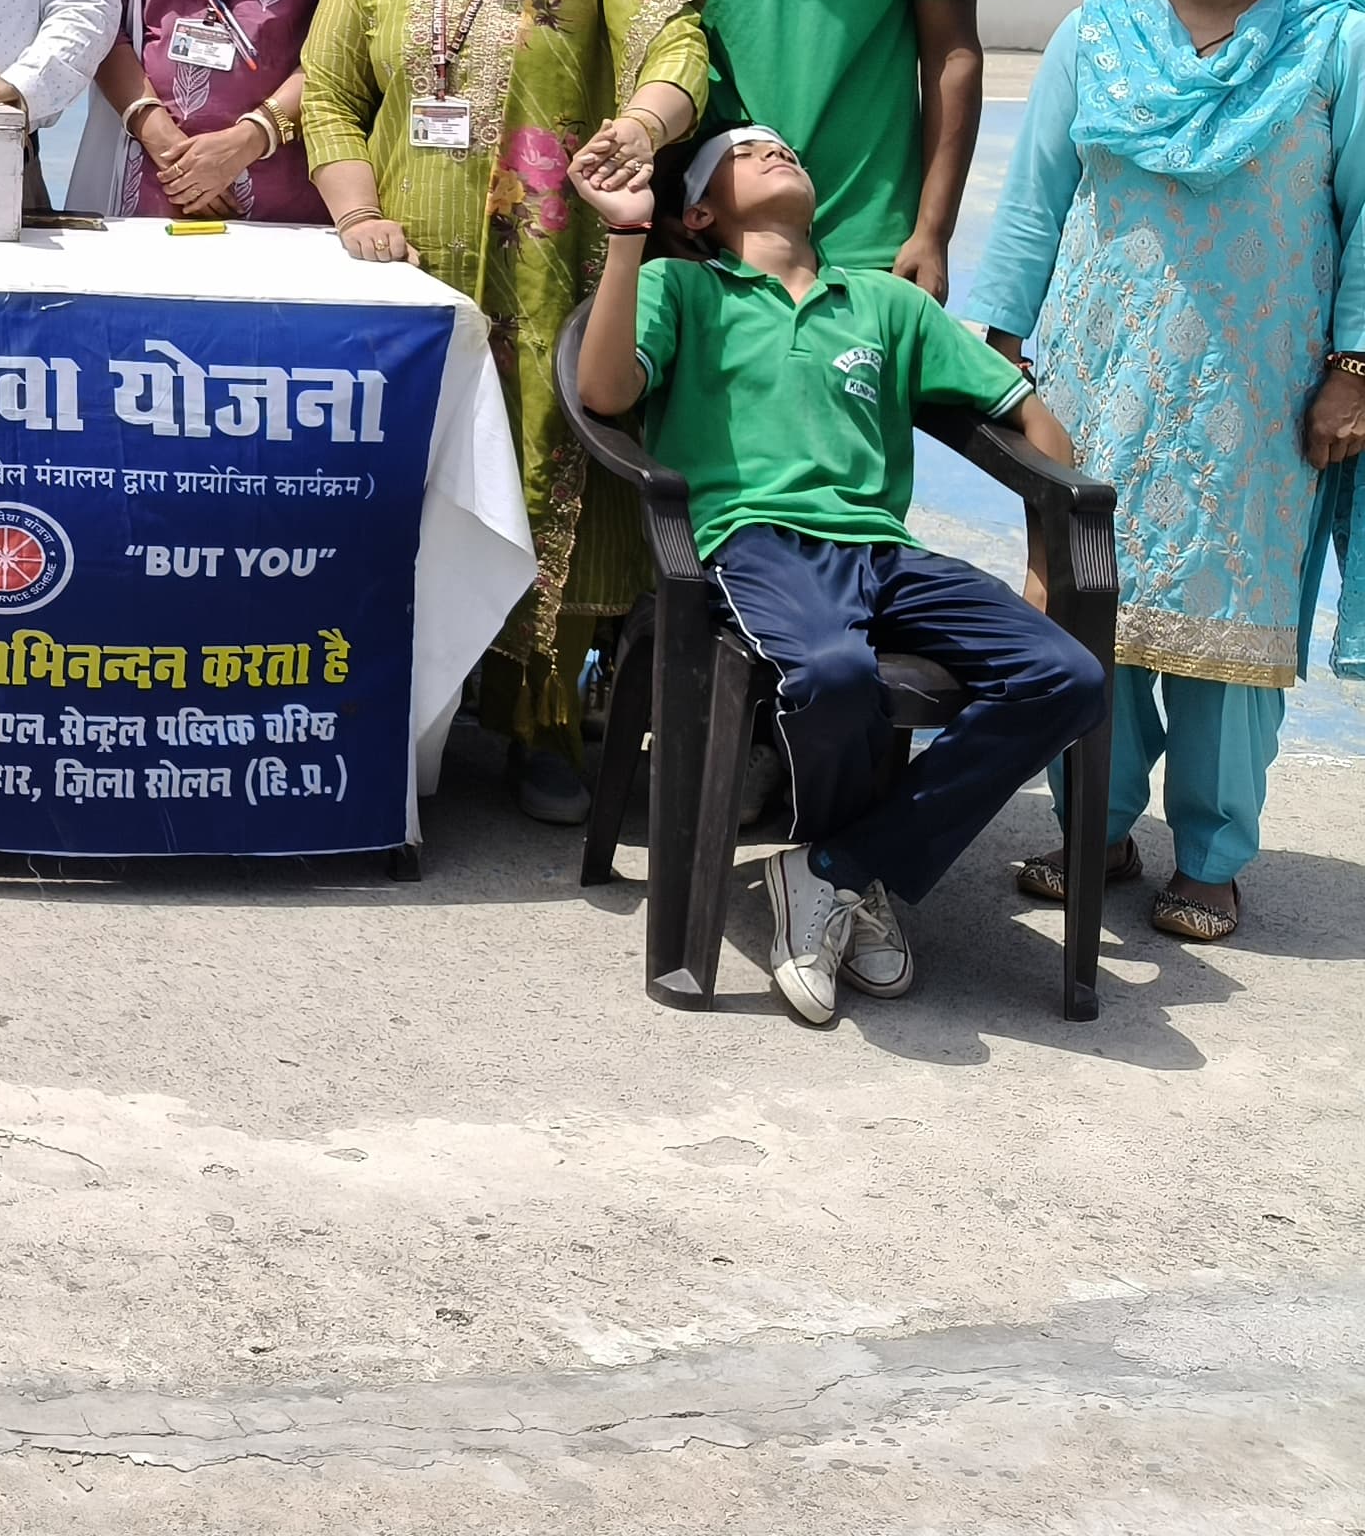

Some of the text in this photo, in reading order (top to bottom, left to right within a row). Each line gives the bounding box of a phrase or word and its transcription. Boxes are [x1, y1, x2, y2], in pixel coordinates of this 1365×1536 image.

[108, 338, 388, 443] योजना
[33, 457, 116, 490] मंत्रालय
[121, 467, 169, 496] द्वारा
[173, 464, 268, 497] प्रायोजित
[274, 467, 362, 498] कार्यक्रम
[30, 563, 57, 595] SCHEME
[200, 643, 313, 689] करता
[316, 627, 352, 684] है
[156, 706, 256, 747] पब्लिक
[144, 759, 233, 800] सोलन
